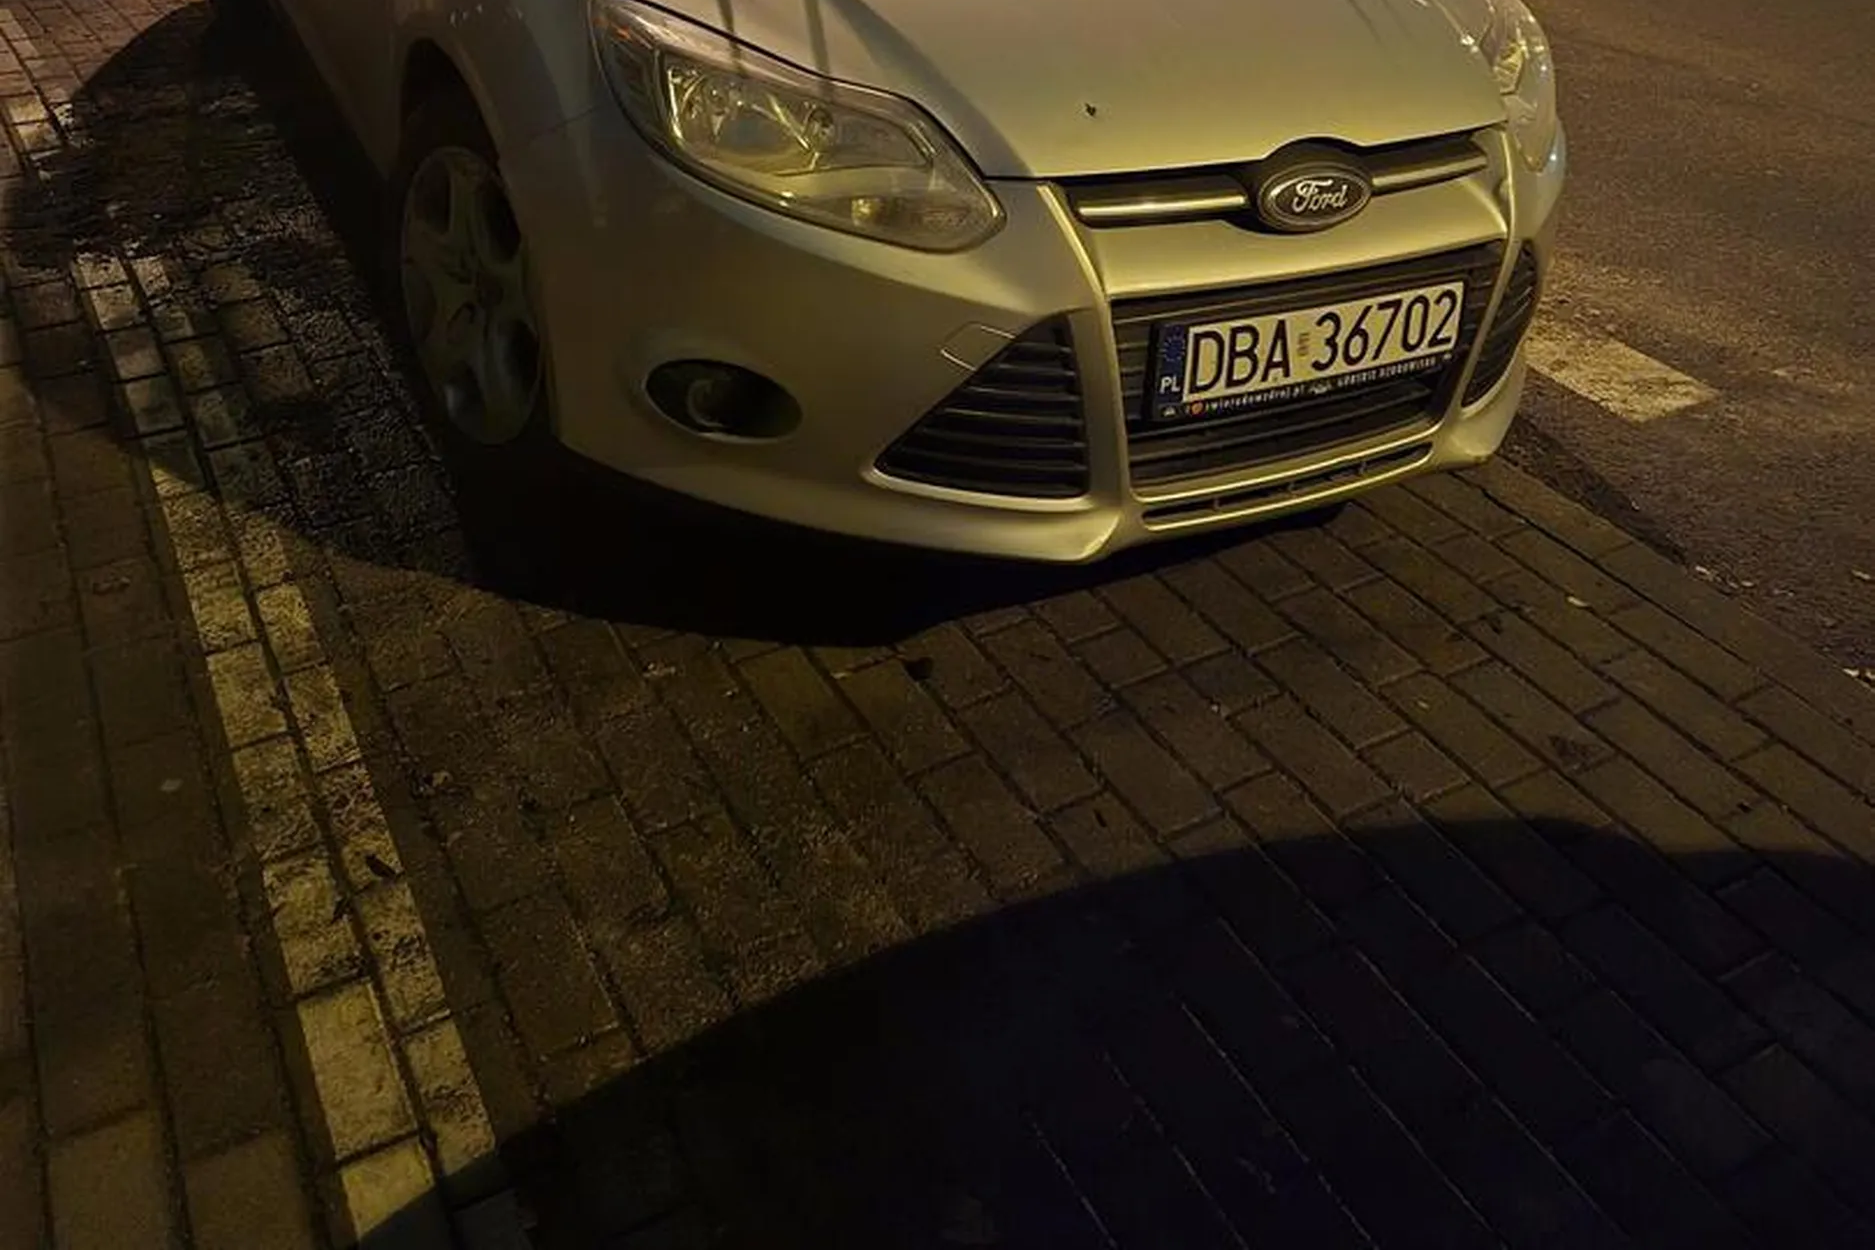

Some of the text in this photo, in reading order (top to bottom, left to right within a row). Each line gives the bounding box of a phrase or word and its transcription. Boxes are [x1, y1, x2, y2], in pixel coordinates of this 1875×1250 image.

[1292, 179, 1348, 213] Ford
[1188, 289, 1457, 395] DBA 36702
[1159, 375, 1180, 394] PL
